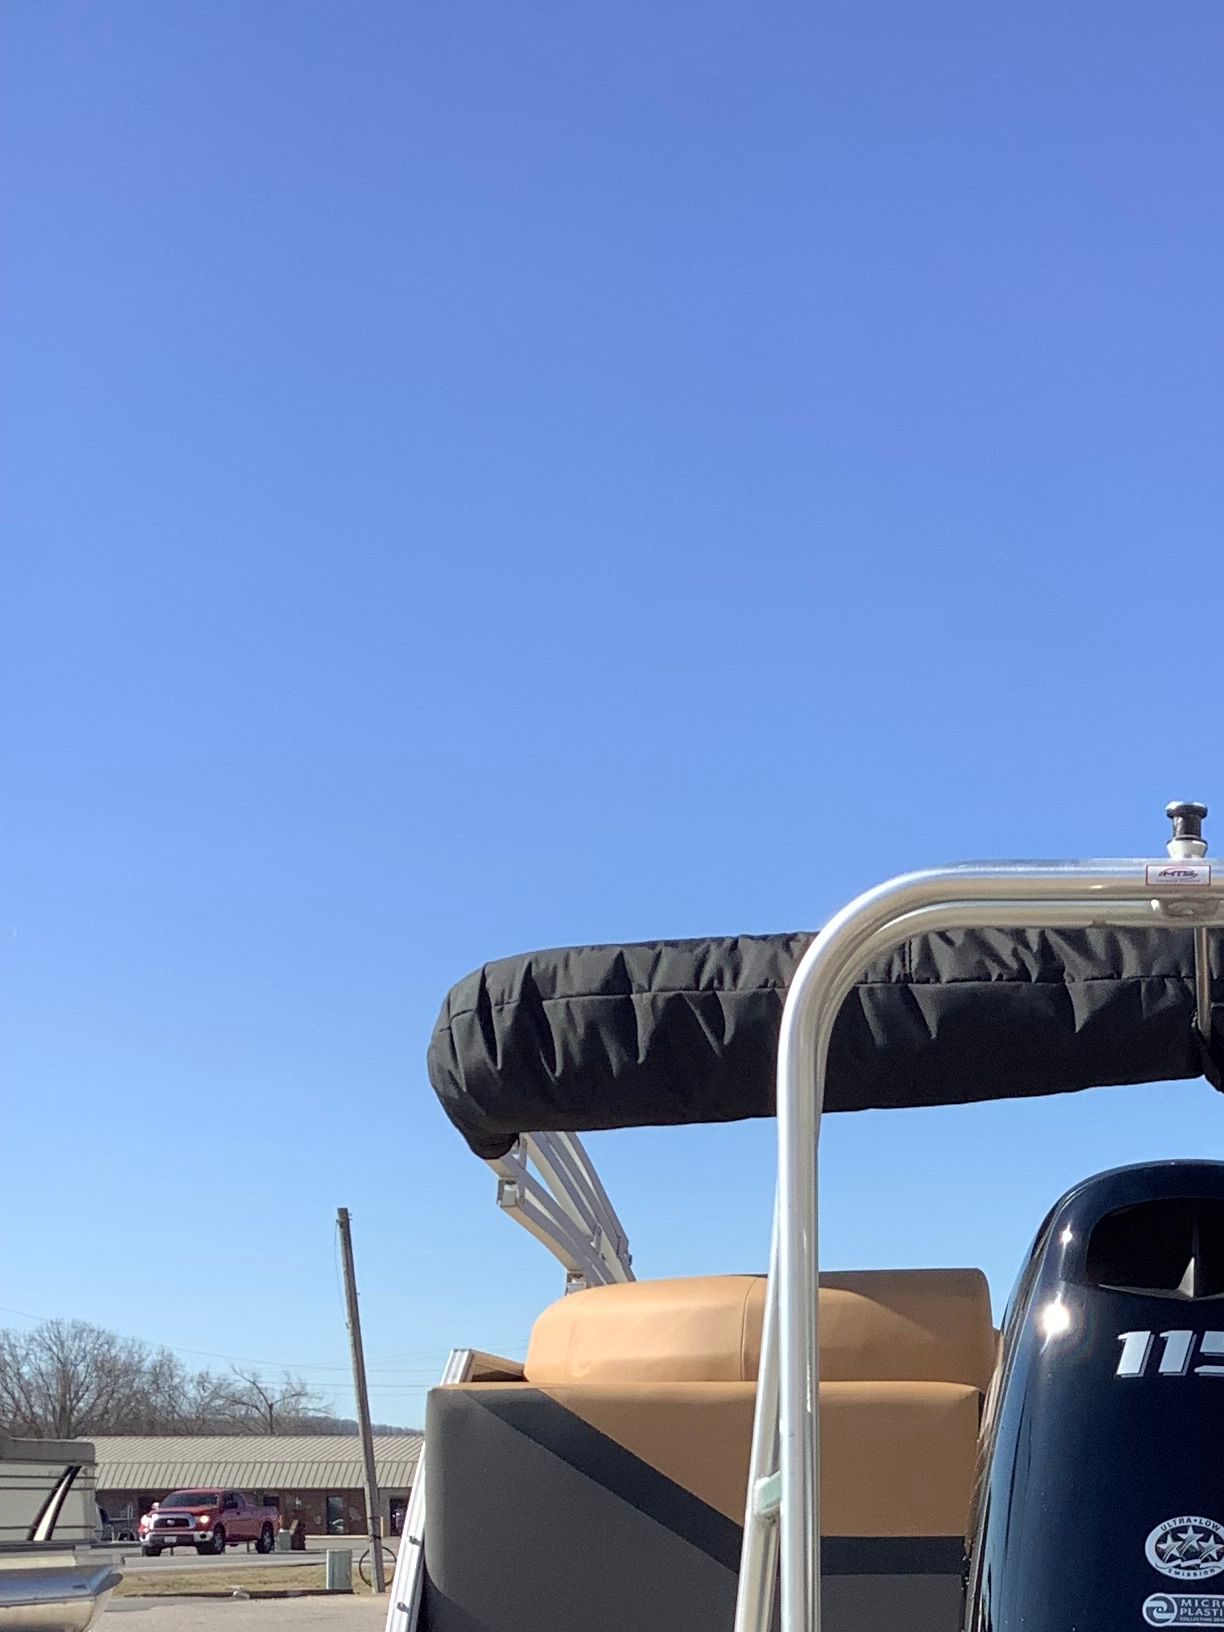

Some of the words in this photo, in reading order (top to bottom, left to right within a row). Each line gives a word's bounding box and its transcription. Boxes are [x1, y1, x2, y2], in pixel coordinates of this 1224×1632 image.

[1161, 1517, 1192, 1531] ULTRA
[1199, 1517, 1221, 1531] LOW
[1168, 1568, 1216, 1578] EMISSION
